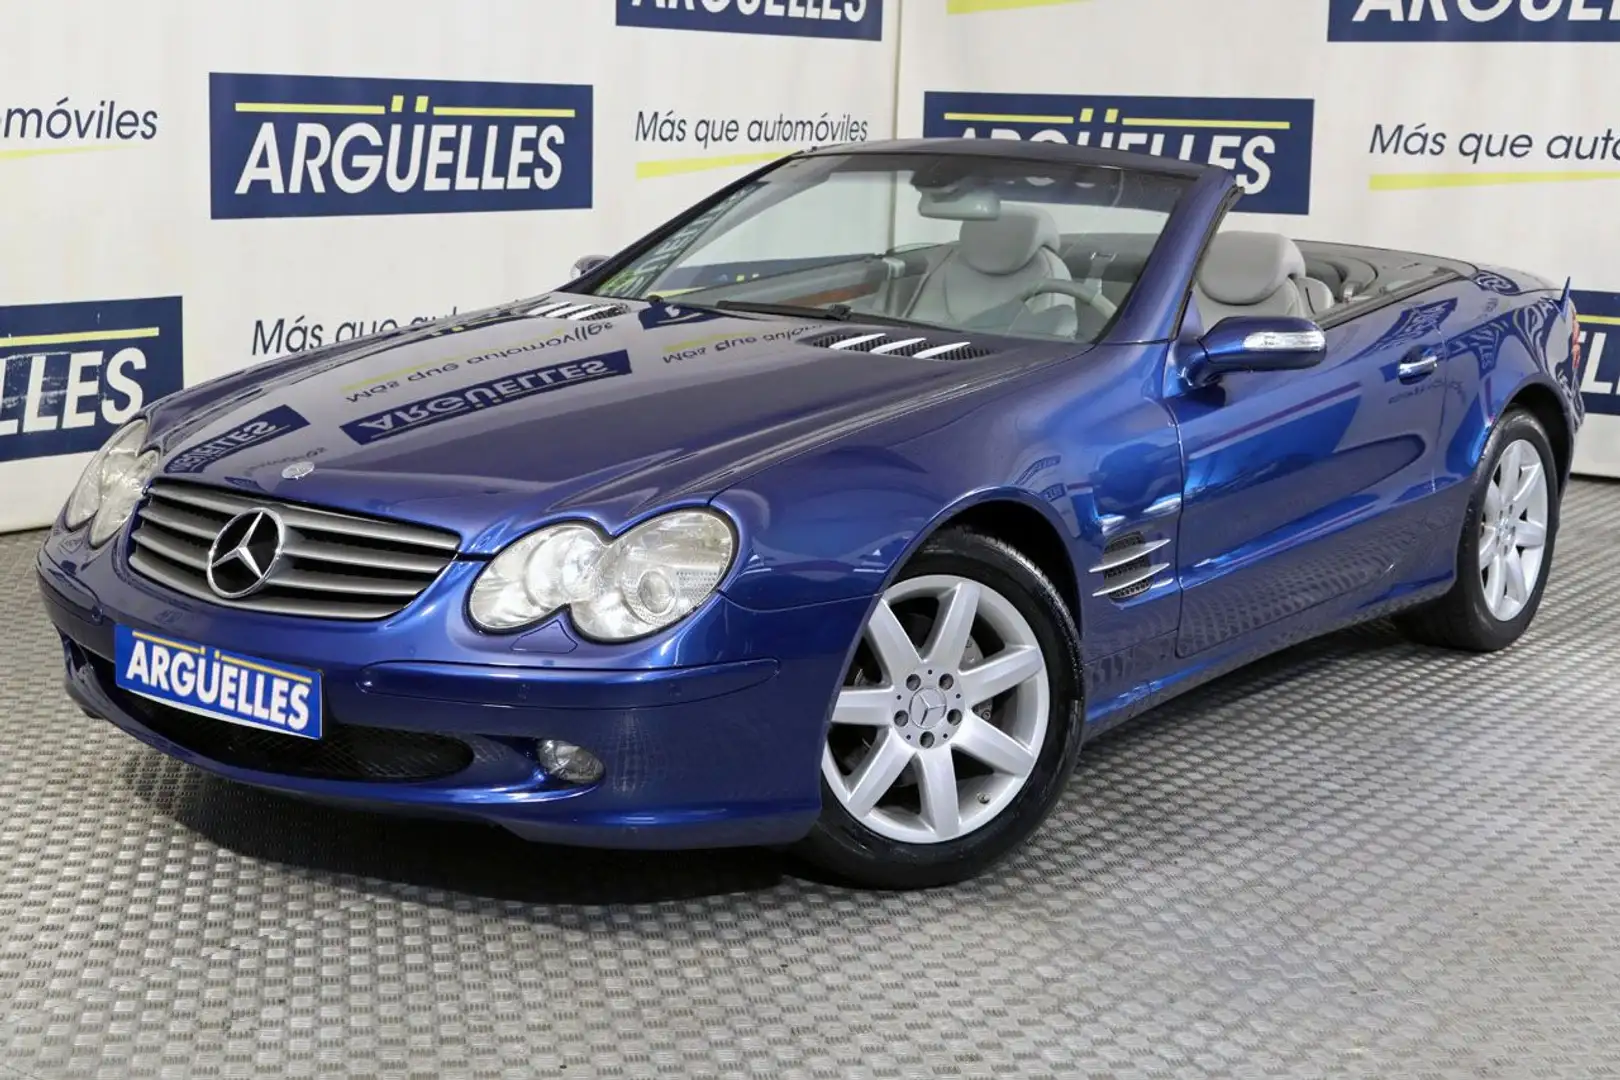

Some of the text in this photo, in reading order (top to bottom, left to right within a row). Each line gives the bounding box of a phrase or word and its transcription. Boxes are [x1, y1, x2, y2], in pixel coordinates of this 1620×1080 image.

[0, 96, 158, 140] móviles
[635, 110, 868, 149] Más que automóviles
[234, 95, 565, 194] ARGÜELLES
[1369, 122, 1447, 156] Más
[1458, 132, 1533, 164] que
[251, 315, 323, 356] Más
[126, 640, 310, 730] ARGÜELLES
